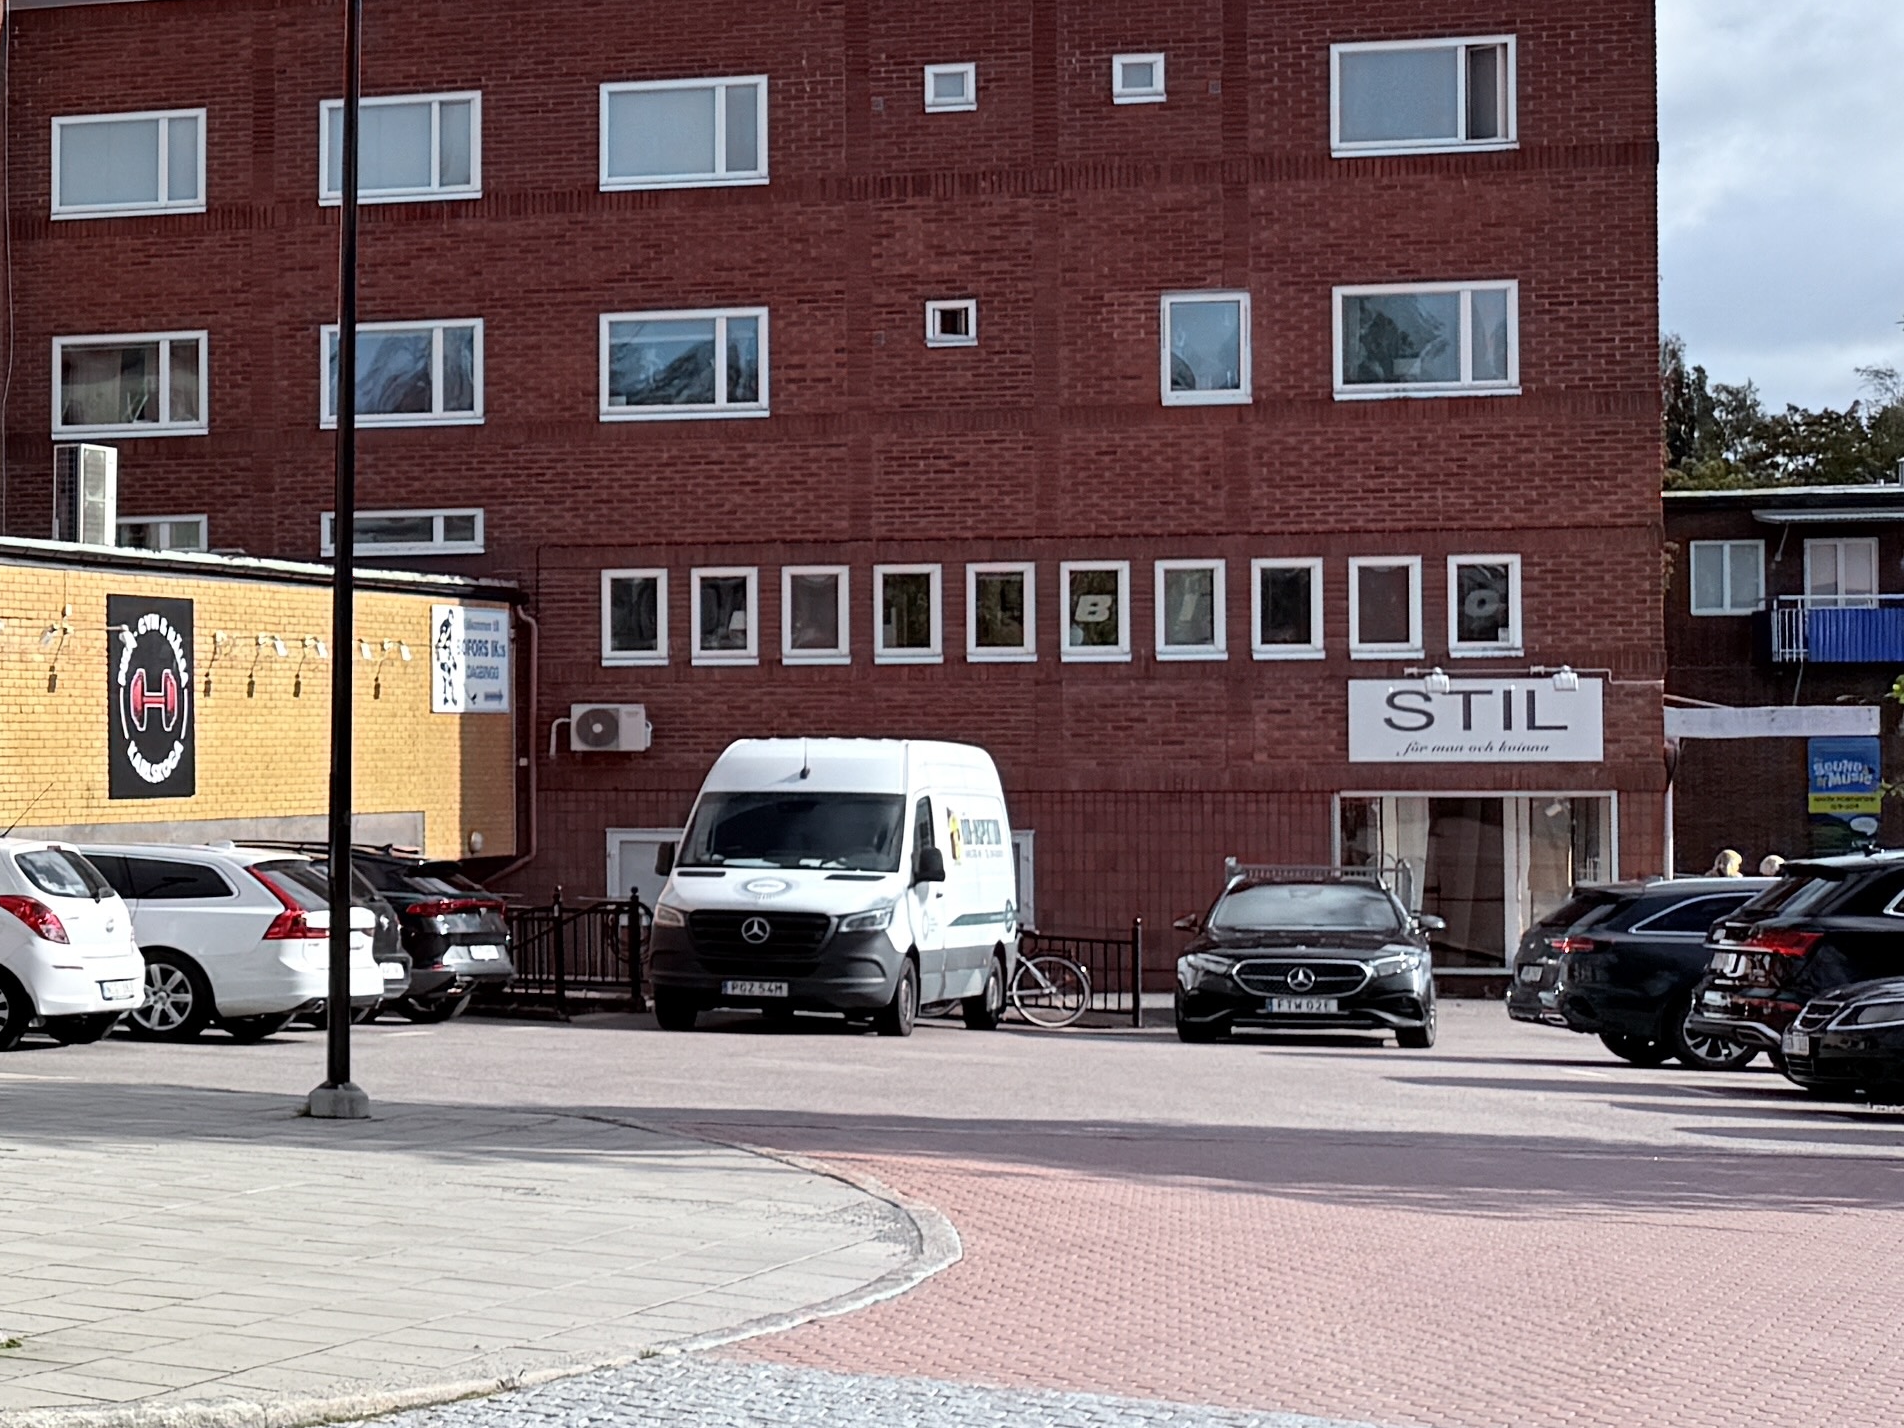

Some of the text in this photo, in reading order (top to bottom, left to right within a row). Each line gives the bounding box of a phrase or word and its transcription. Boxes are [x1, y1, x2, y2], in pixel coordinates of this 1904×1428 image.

[1074, 594, 1113, 623] B
[1383, 689, 1568, 731] STIL
[1396, 740, 1428, 757] för
[1431, 744, 1463, 754] man
[1468, 740, 1493, 753] och
